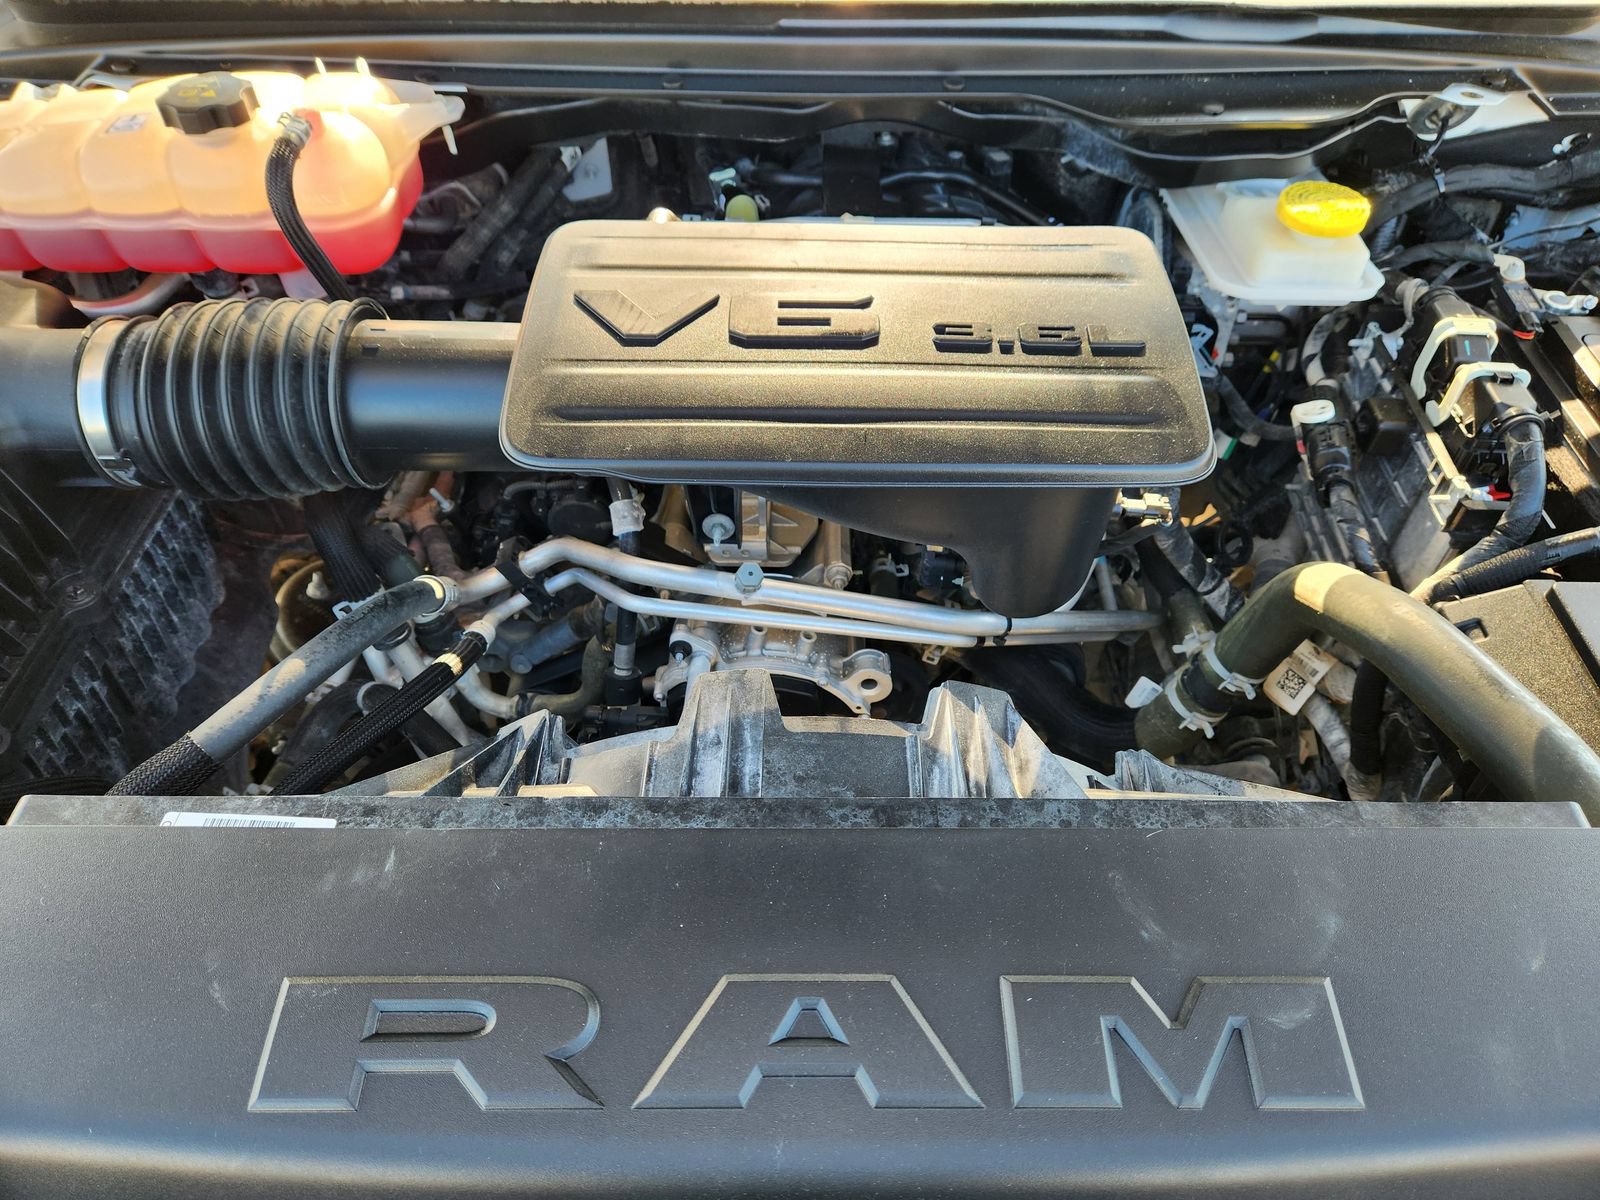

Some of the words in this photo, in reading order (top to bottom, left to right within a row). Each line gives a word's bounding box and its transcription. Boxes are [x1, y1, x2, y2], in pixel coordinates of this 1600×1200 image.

[573, 289, 880, 350] V6
[931, 322, 1146, 357] 3.6L
[247, 973, 1367, 1113] RAM
